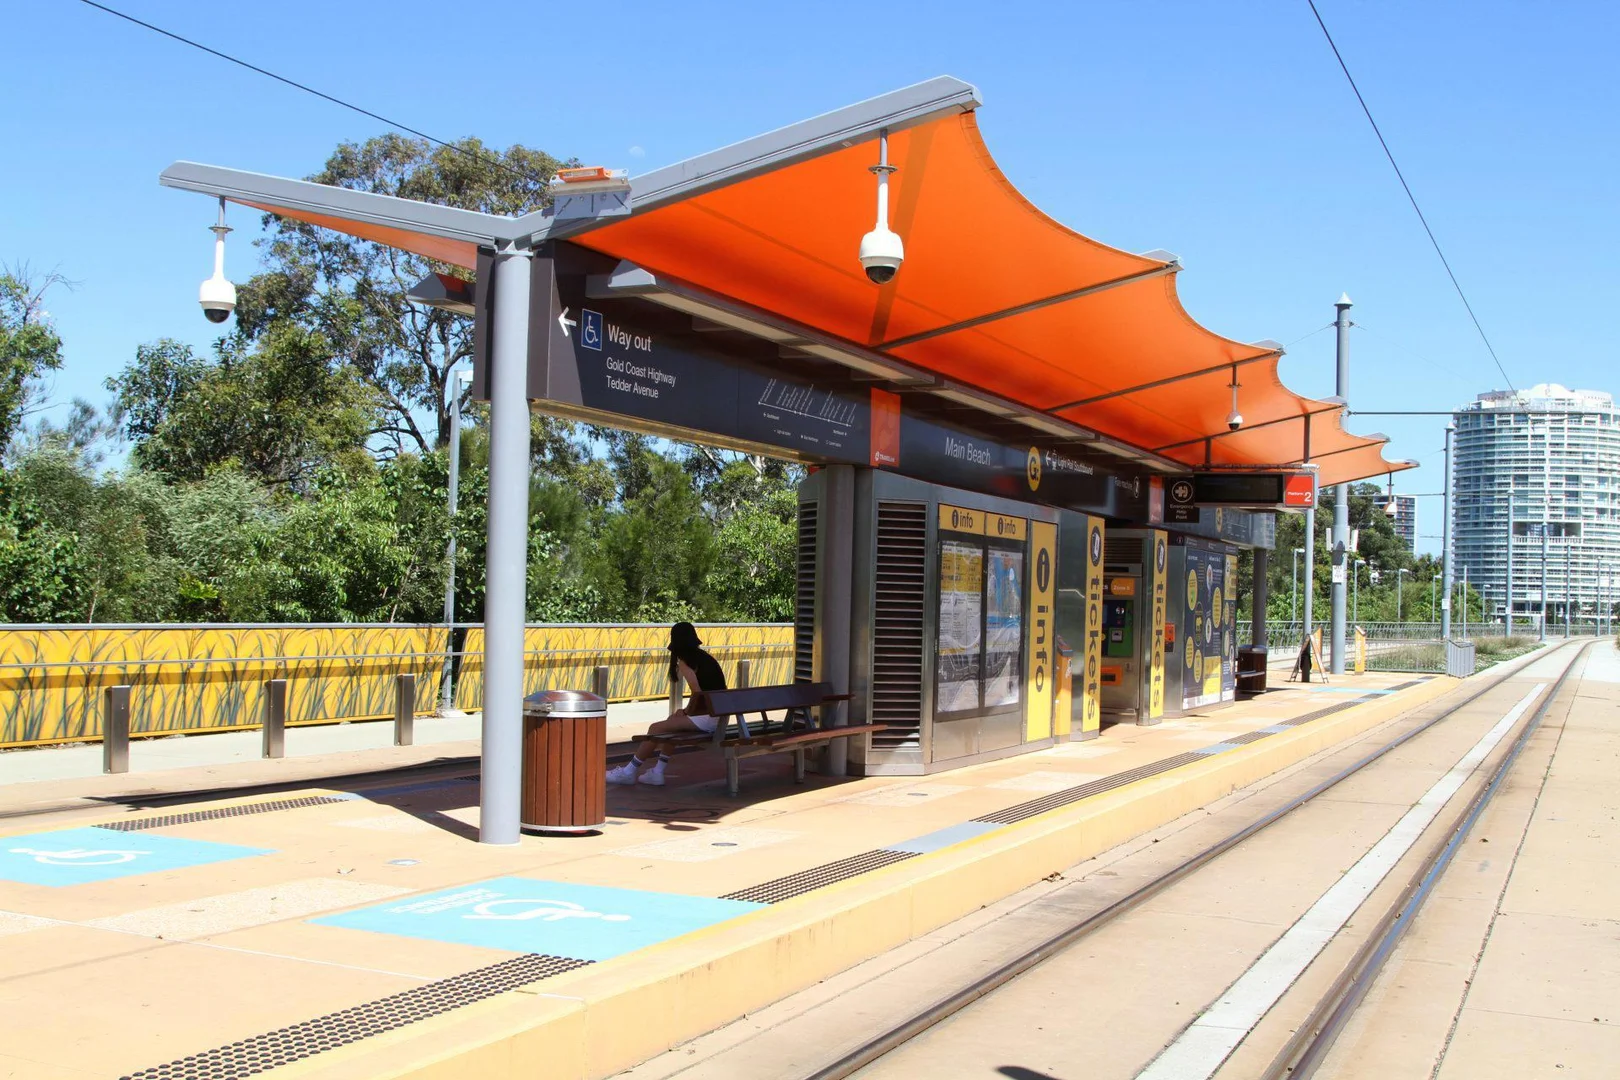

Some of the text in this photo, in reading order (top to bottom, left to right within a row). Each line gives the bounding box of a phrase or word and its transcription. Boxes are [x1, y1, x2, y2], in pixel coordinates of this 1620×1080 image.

[608, 324, 652, 352] Way out
[606, 356, 677, 388] Gold Coast Highway
[606, 375, 659, 399] Tedder Avenue
[945, 437, 991, 466] Main Beach
[1304, 491, 1312, 502] 2
[959, 512, 974, 529] info
[1003, 515, 1016, 534] info
[1036, 605, 1049, 692] info
[1088, 577, 1100, 720] tickets
[1154, 583, 1164, 708] tickets
